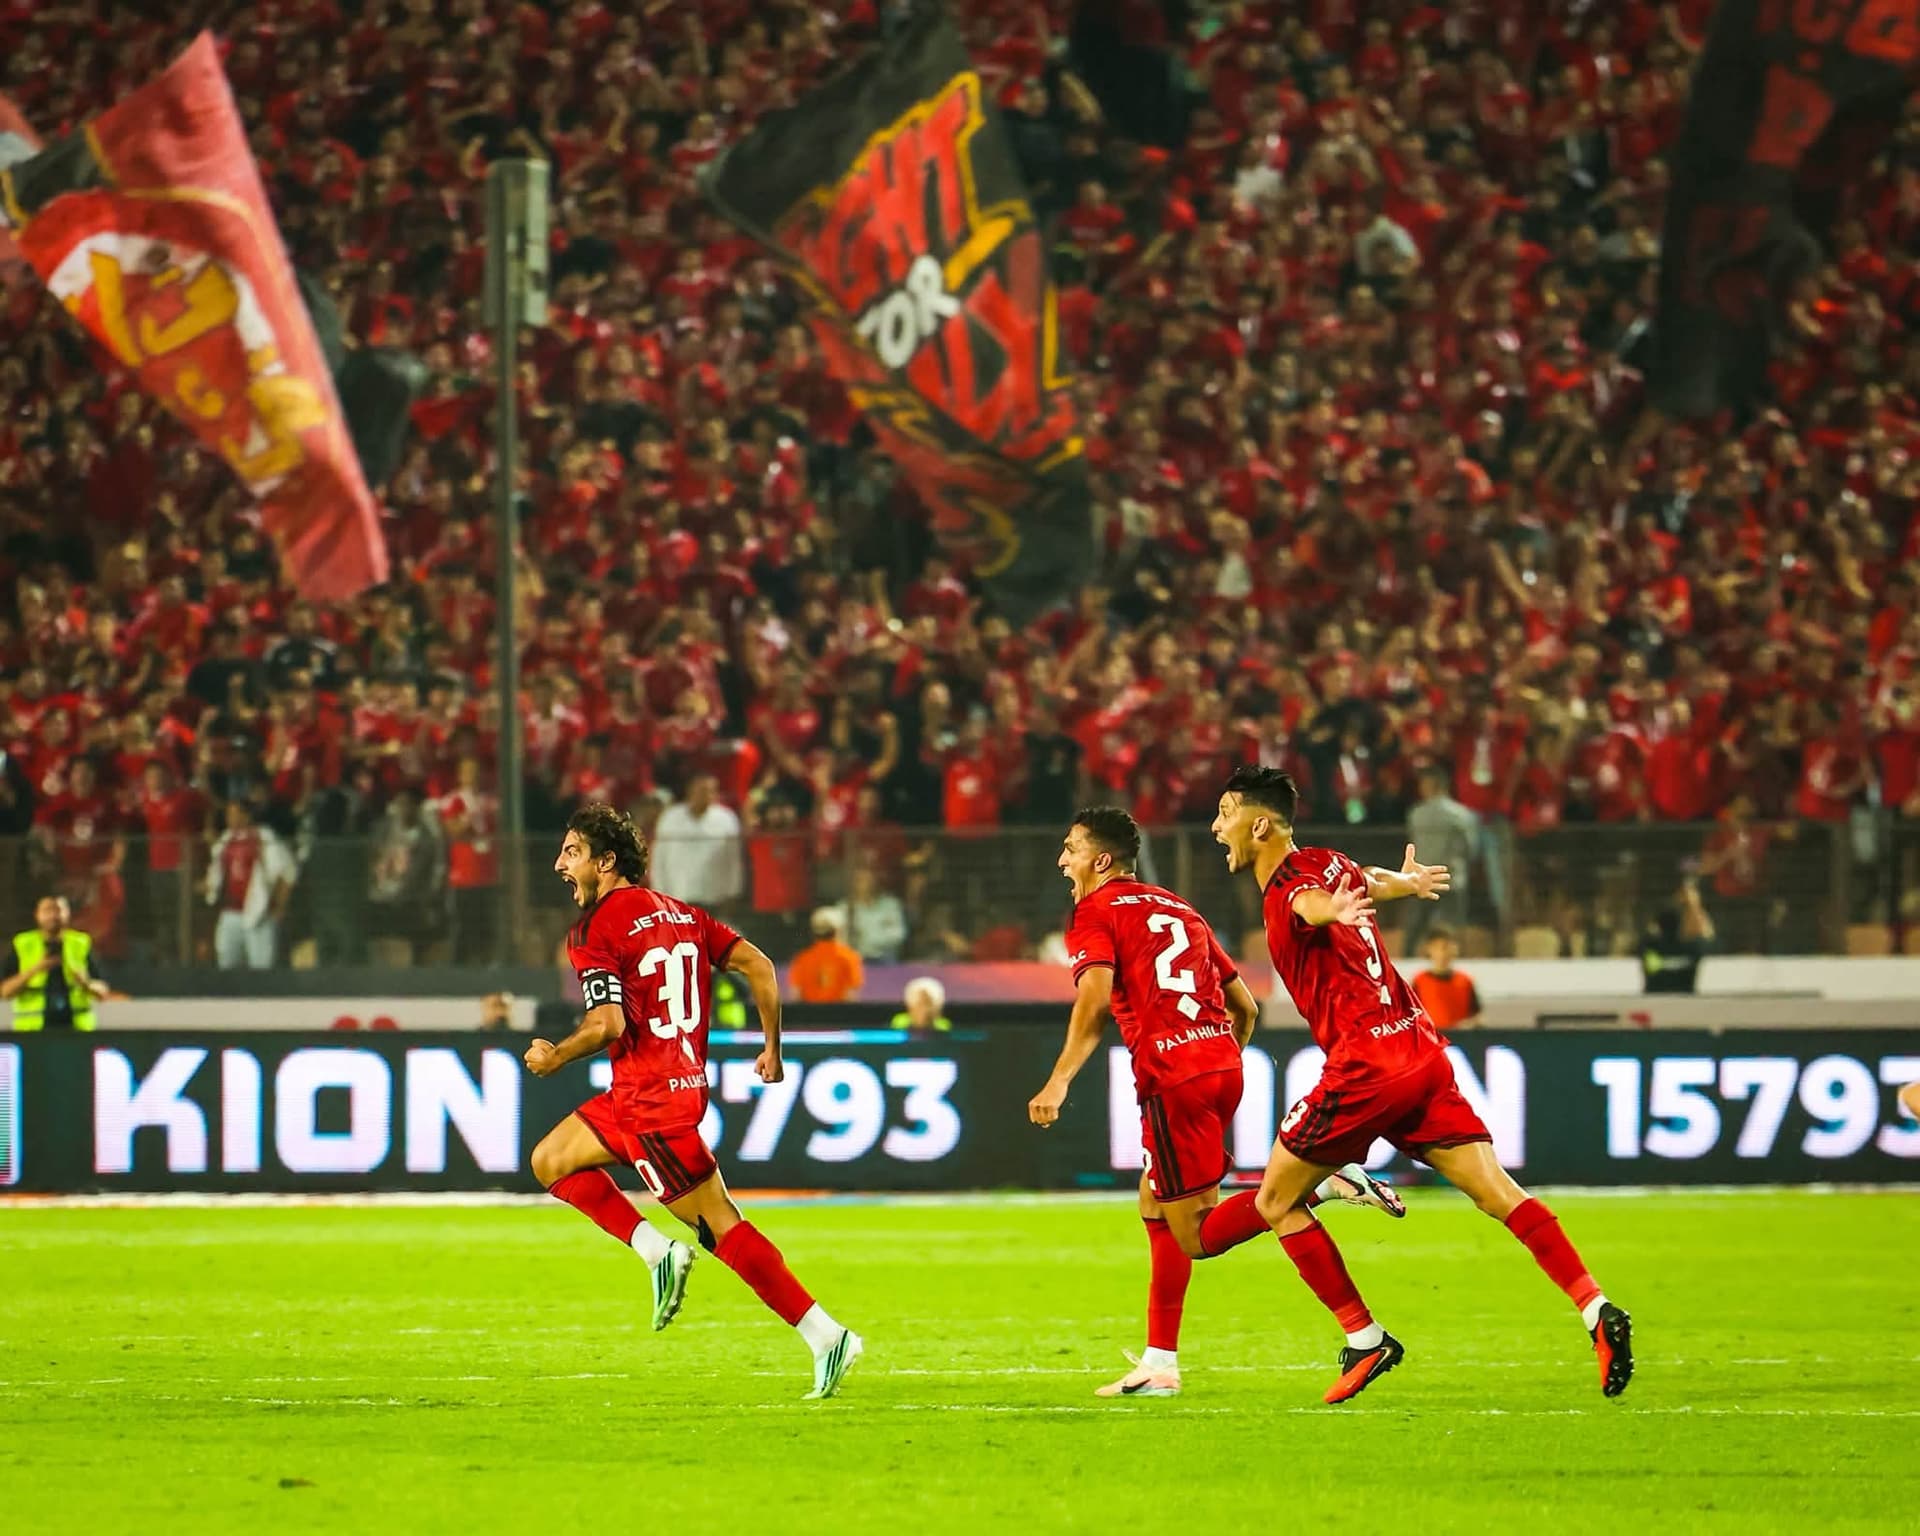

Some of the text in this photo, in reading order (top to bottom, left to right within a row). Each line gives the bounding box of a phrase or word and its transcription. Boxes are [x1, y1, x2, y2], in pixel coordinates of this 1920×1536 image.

[637, 941, 701, 1040] 30
[1146, 912, 1197, 993] 2
[94, 1047, 961, 1173] KION 793
